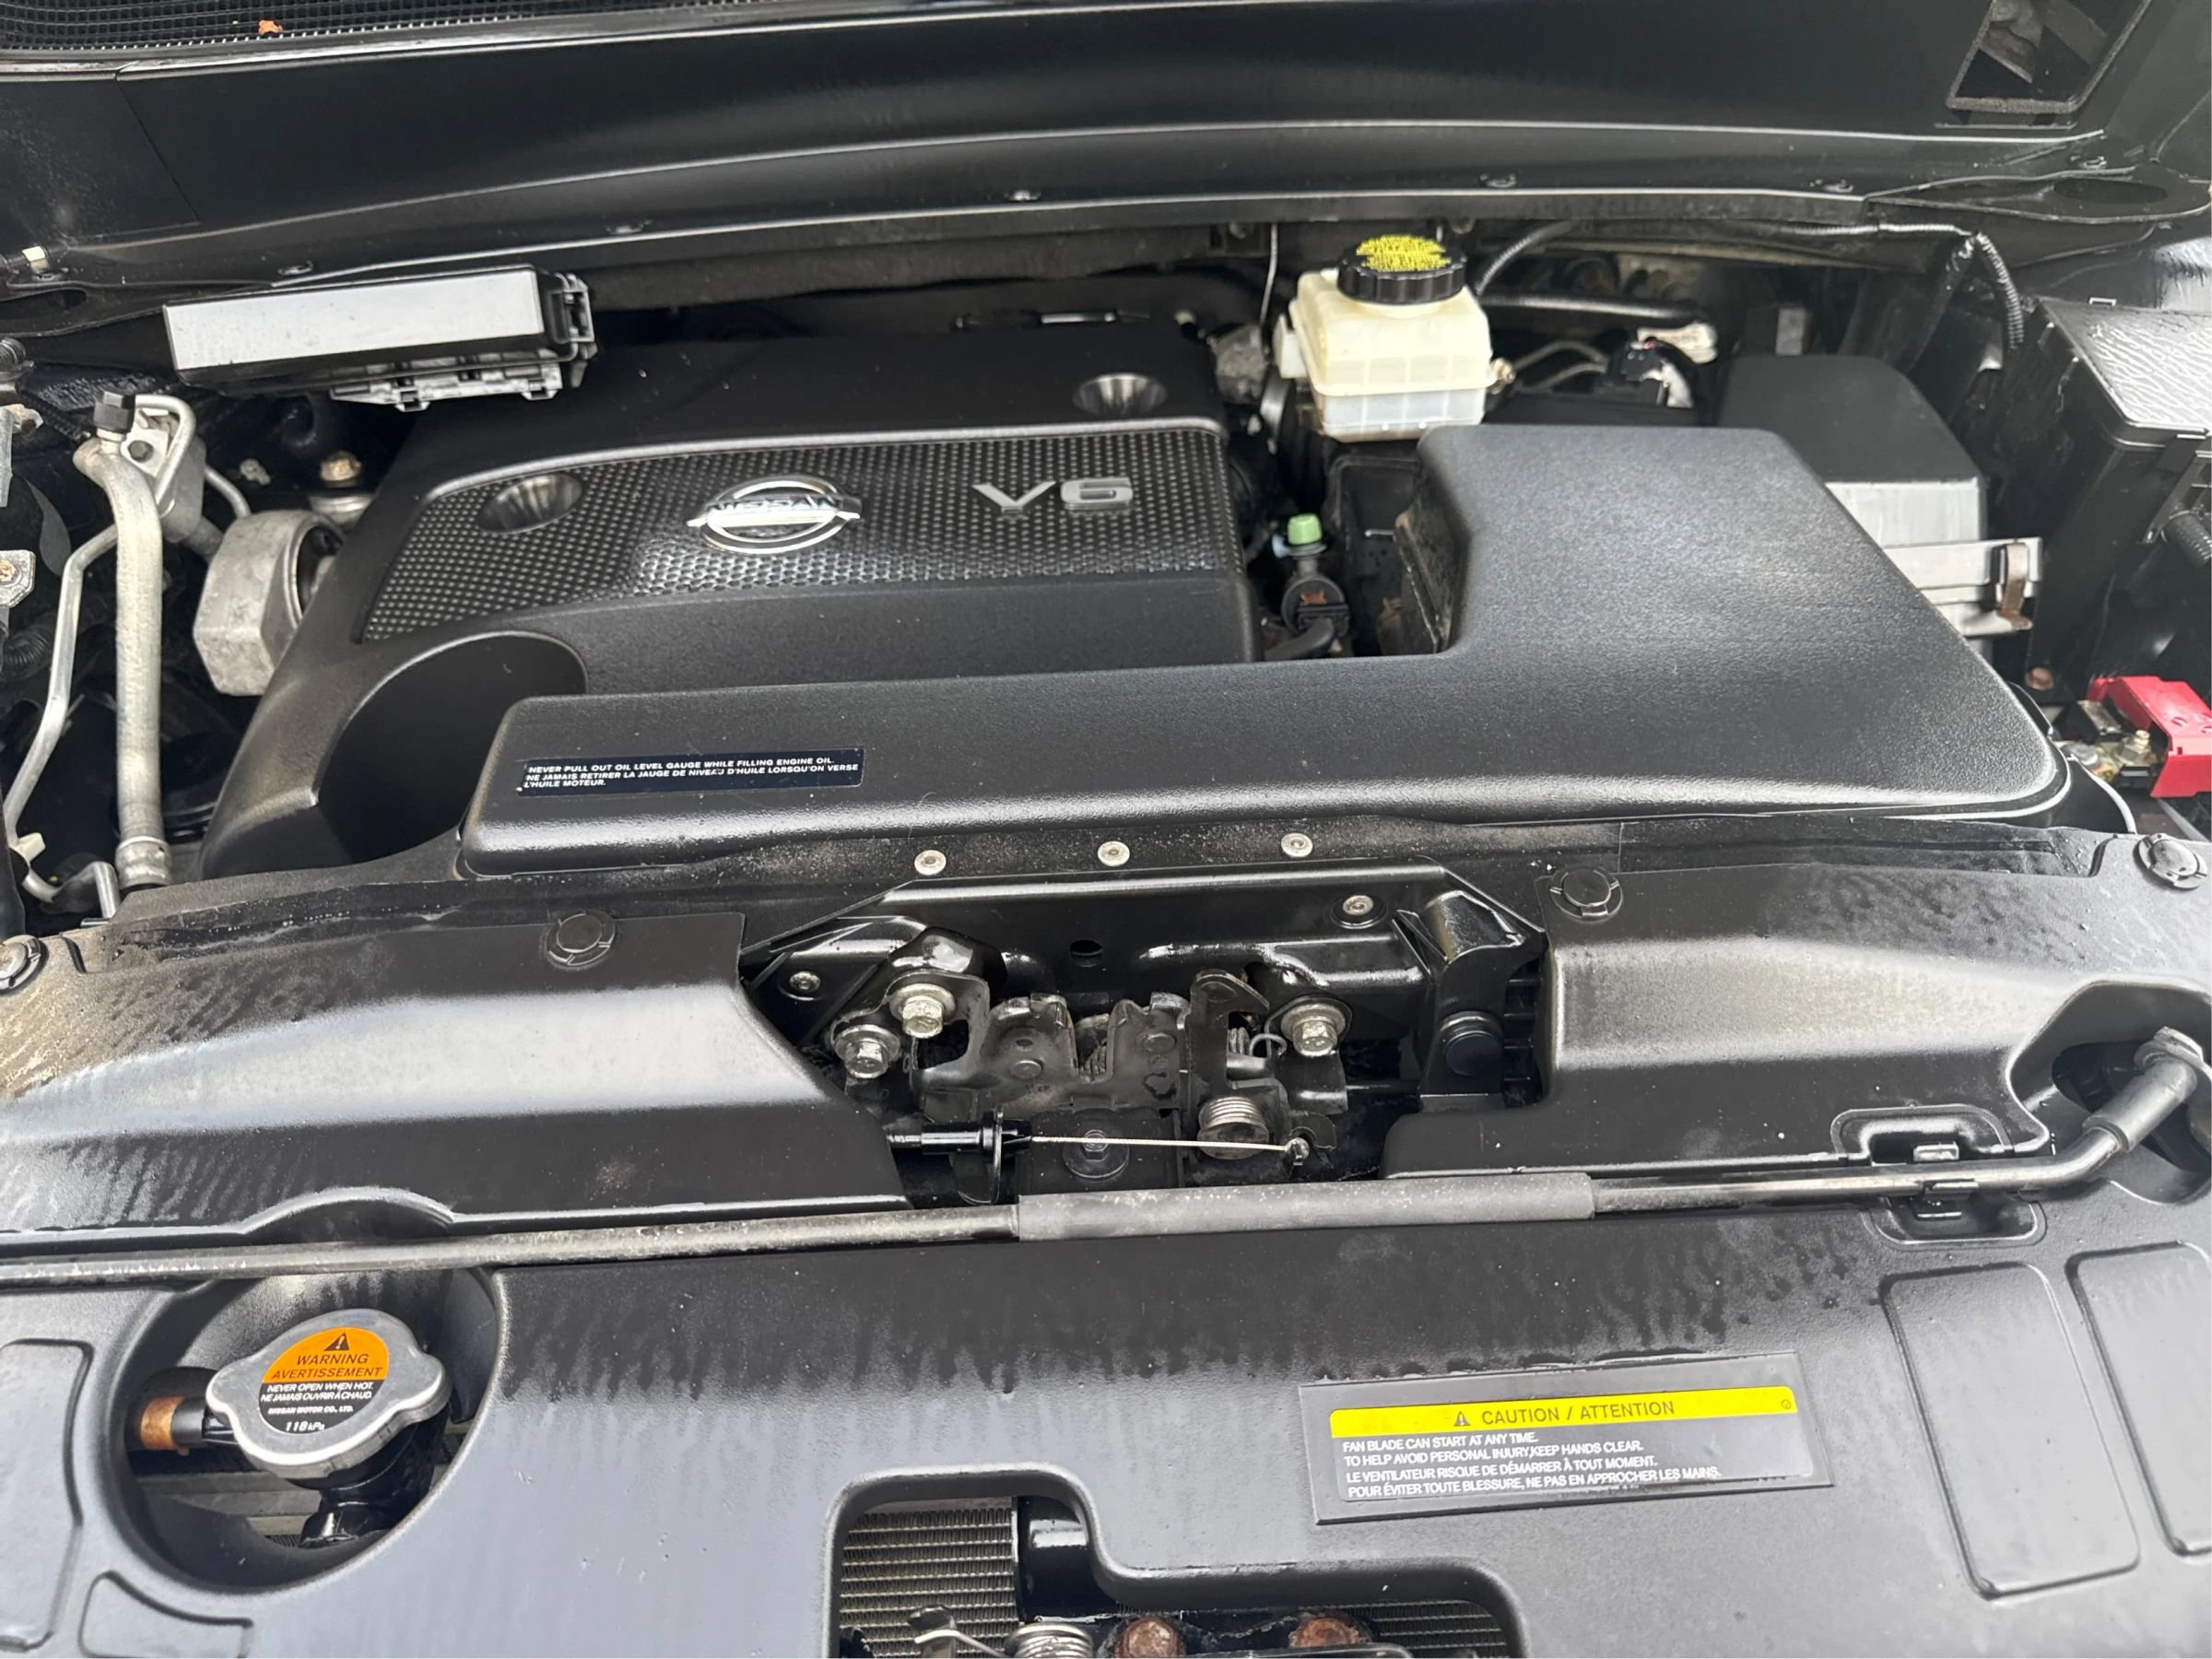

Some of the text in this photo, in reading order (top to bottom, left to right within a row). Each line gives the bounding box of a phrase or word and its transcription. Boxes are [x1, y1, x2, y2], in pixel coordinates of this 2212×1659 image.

[971, 477, 1134, 510] V6
[665, 761, 701, 770] GAUGE
[776, 758, 814, 766] ENGINE
[580, 771, 621, 780] RETIRER
[623, 771, 636, 779] LA
[638, 770, 670, 778] JAUGE
[727, 767, 765, 775] D'HUILE
[768, 765, 825, 773] LORSQU'ON
[563, 779, 606, 787] MOTEUR.
[297, 1353, 370, 1366] WARNING
[272, 1367, 382, 1380] AVERTISSEMENT
[267, 1383, 297, 1393] NEVER
[298, 1382, 324, 1392] OPEN
[324, 1382, 353, 1391] WHEN
[261, 1394, 274, 1402] NE
[273, 1393, 302, 1402] JAMAIS
[1481, 1401, 1676, 1425] CAUTION / ATTENTION
[1343, 1441, 1366, 1453] FAN
[1367, 1439, 1405, 1452] BLADE
[1406, 1437, 1430, 1450] CAN
[1432, 1435, 1467, 1448] START
[1469, 1435, 1483, 1447] AT
[1484, 1433, 1508, 1446] ANY
[1345, 1455, 1360, 1467] TO
[1363, 1453, 1392, 1466] HELP
[1394, 1452, 1429, 1465] AVOID
[1430, 1449, 1491, 1463] PERSONAL
[1561, 1442, 1602, 1455] HANDS
[1603, 1440, 1644, 1453] CLEAR.
[1347, 1472, 1361, 1484] LE
[1361, 1467, 1436, 1482] VENTILATEUR
[1437, 1465, 1479, 1479] RISQUE
[1482, 1465, 1497, 1477] DE
[1499, 1460, 1562, 1476] DÉMARRER
[1572, 1458, 1604, 1471] TOUT
[1605, 1455, 1658, 1469] MOMENT.
[1348, 1485, 1382, 1499] POUR
[1383, 1482, 1423, 1497] ÉVITER
[1425, 1480, 1462, 1494] TOUTE
[1525, 1476, 1543, 1489] NE
[1544, 1475, 1568, 1488] PAS
[1568, 1474, 1585, 1487] EN
[1586, 1469, 1657, 1486] APPROCHER
[1659, 1467, 1679, 1480] LES
[1682, 1465, 1722, 1479] MAINS.
